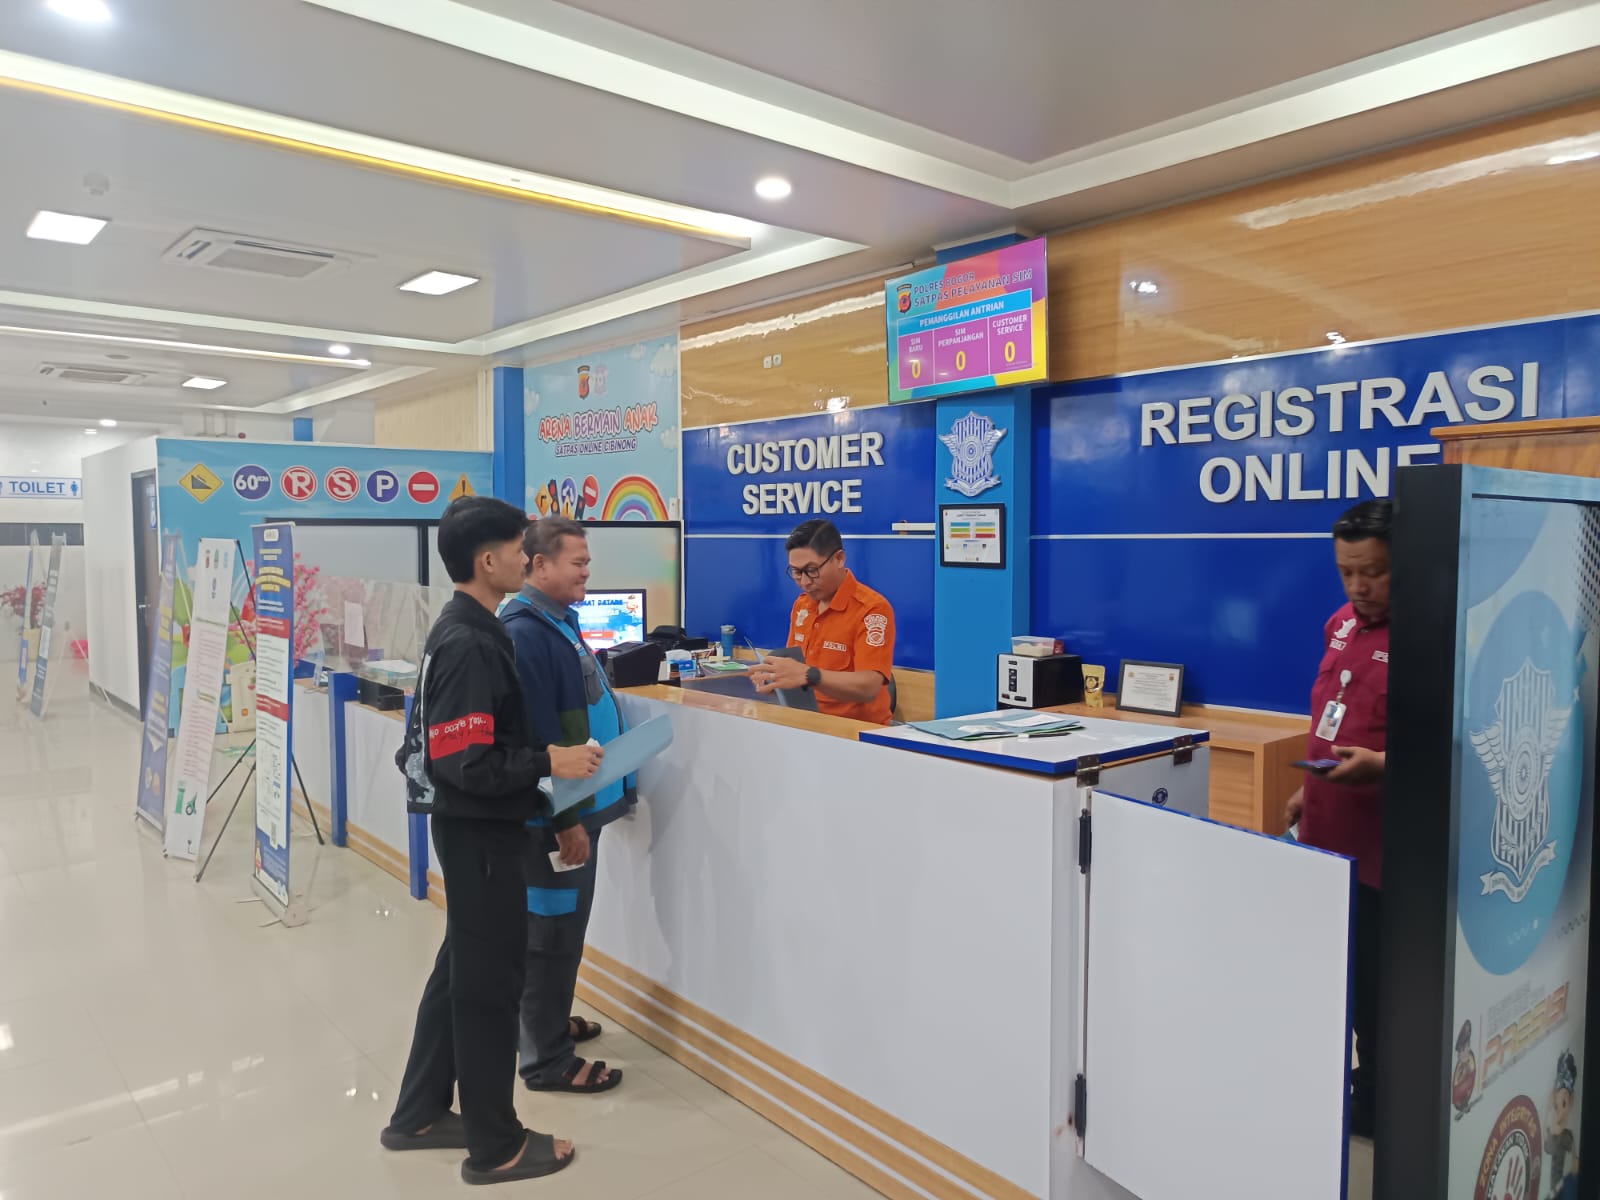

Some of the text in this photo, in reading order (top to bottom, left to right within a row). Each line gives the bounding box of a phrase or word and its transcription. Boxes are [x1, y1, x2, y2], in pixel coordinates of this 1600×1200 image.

[914, 272, 975, 294] POLRES BOGOR
[914, 268, 1033, 307] SATPAS PELAYANAN SIM
[919, 301, 1004, 327] PEMANGGILAN ANTRIAN
[992, 314, 1027, 328] CUSTOMER
[910, 337, 921, 345] SIM
[938, 332, 984, 347] PERPANJANGAN
[954, 328, 966, 336] SIM
[997, 324, 1024, 336] SERVICE
[909, 344, 923, 352] BARU
[1004, 341, 1016, 363] 0
[912, 359, 921, 379] 0
[955, 350, 966, 371] 0
[1140, 362, 1539, 448] REGISTRASI
[538, 401, 658, 443] ARENA BERMAIN ANAK
[555, 436, 637, 457] SATPAS ONLINE CIBINONG
[727, 431, 885, 475] CUSTOMER
[9, 481, 65, 494] TOILET
[292, 473, 310, 496] R
[333, 473, 352, 496] S
[376, 475, 395, 498] P
[742, 479, 863, 515] SERVICE
[1479, 1138, 1499, 1188] ZONA
[1499, 1106, 1538, 1138] INTEGRITAS
